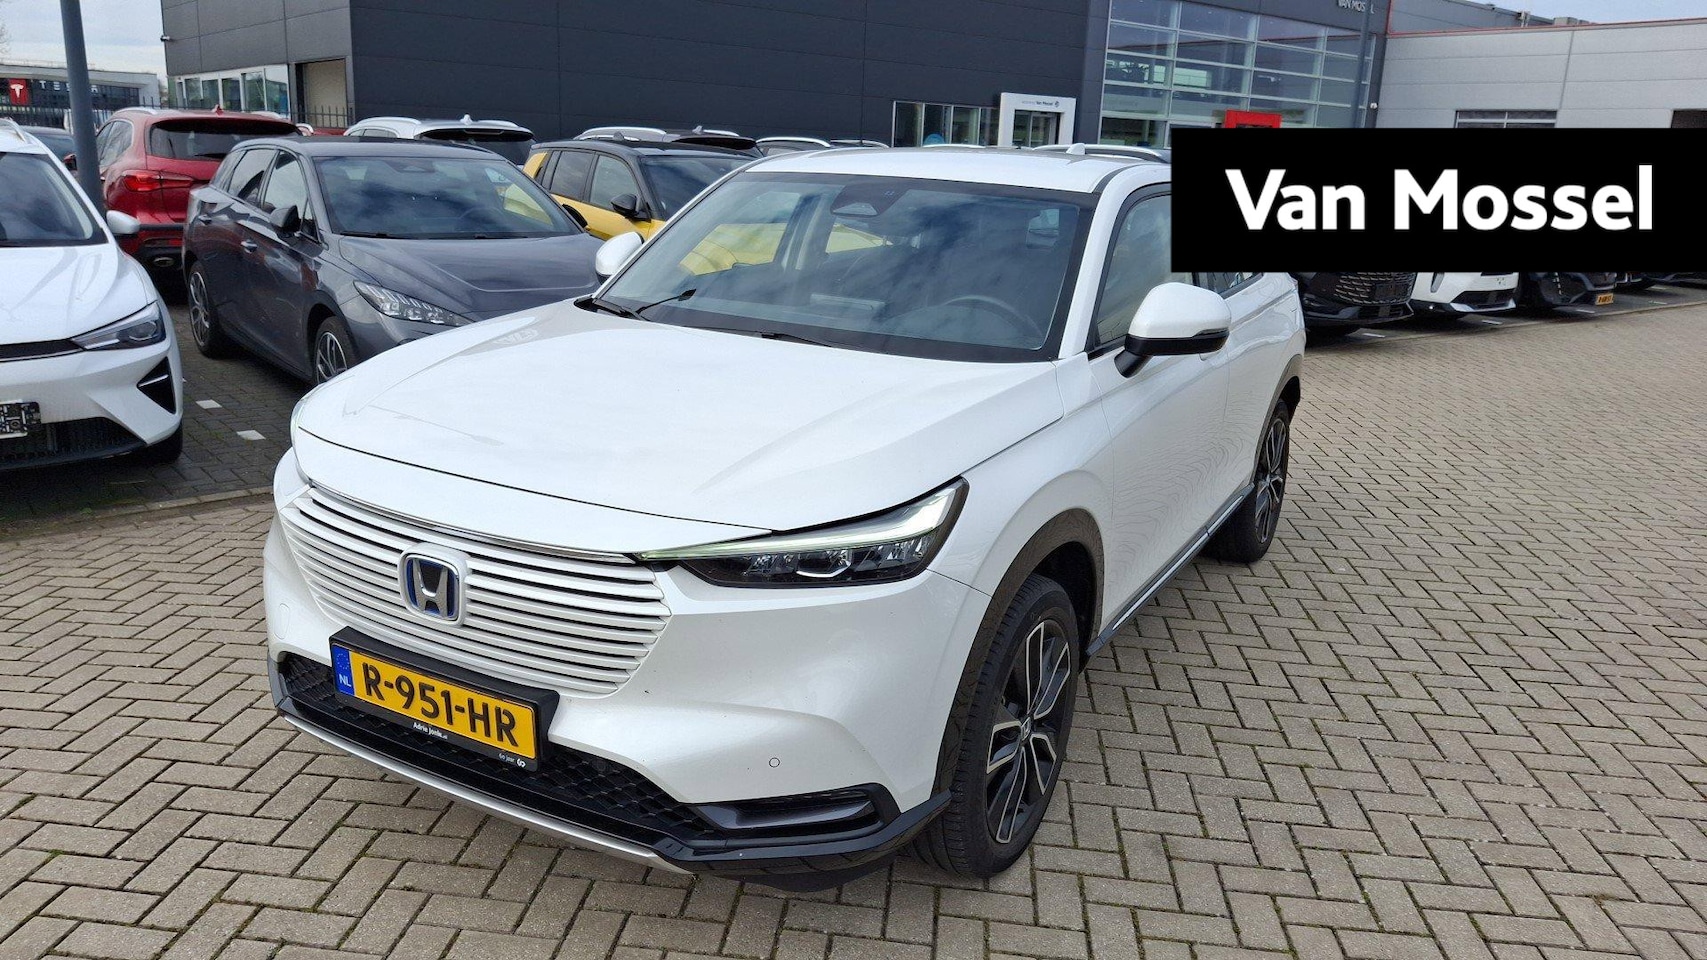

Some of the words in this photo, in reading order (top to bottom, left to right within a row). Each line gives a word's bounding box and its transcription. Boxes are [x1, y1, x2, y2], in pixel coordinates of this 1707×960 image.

[1351, 0, 1375, 14] MOSL
[40, 80, 98, 94] TESA
[338, 674, 352, 688] NL
[361, 661, 519, 748] R-951-HR
